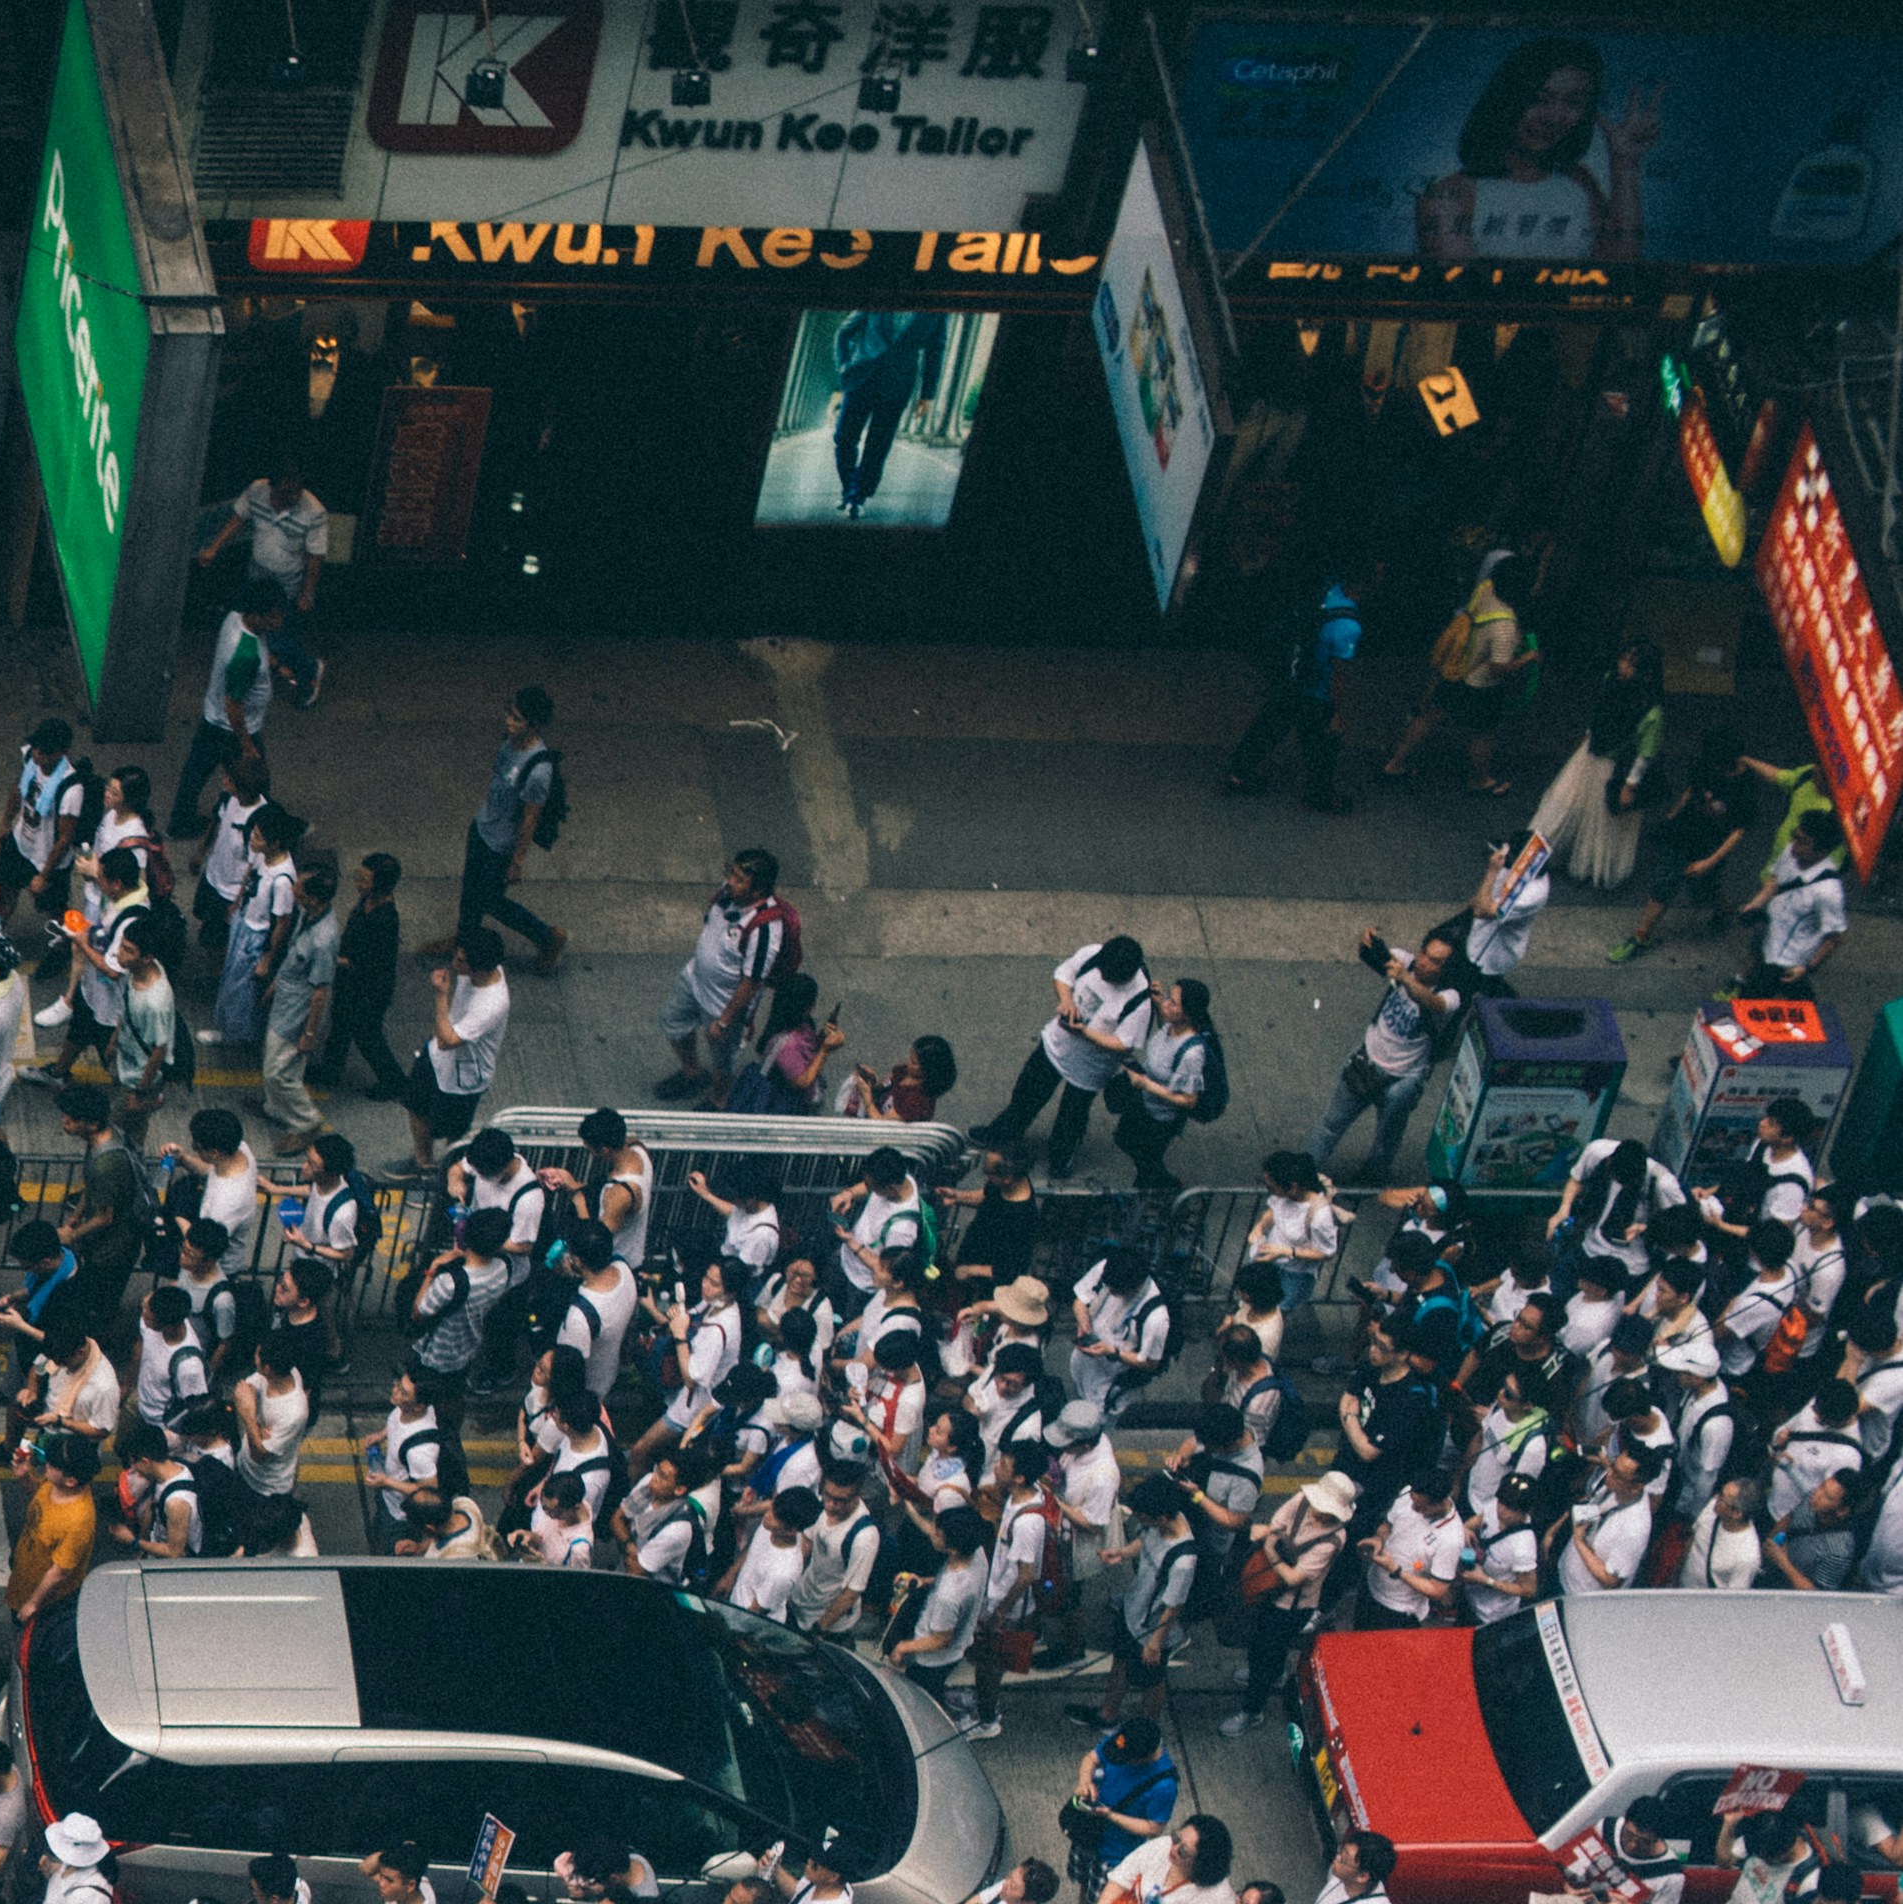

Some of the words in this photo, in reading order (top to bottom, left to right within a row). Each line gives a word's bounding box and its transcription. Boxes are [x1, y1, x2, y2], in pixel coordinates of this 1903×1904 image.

[1233, 59, 1340, 86] Cetaphil
[621, 108, 764, 153] Kwun
[776, 113, 879, 153] Kee
[892, 114, 1034, 158] Tailor
[43, 147, 121, 534] Pricerite
[1739, 1769, 1780, 1791] NO
